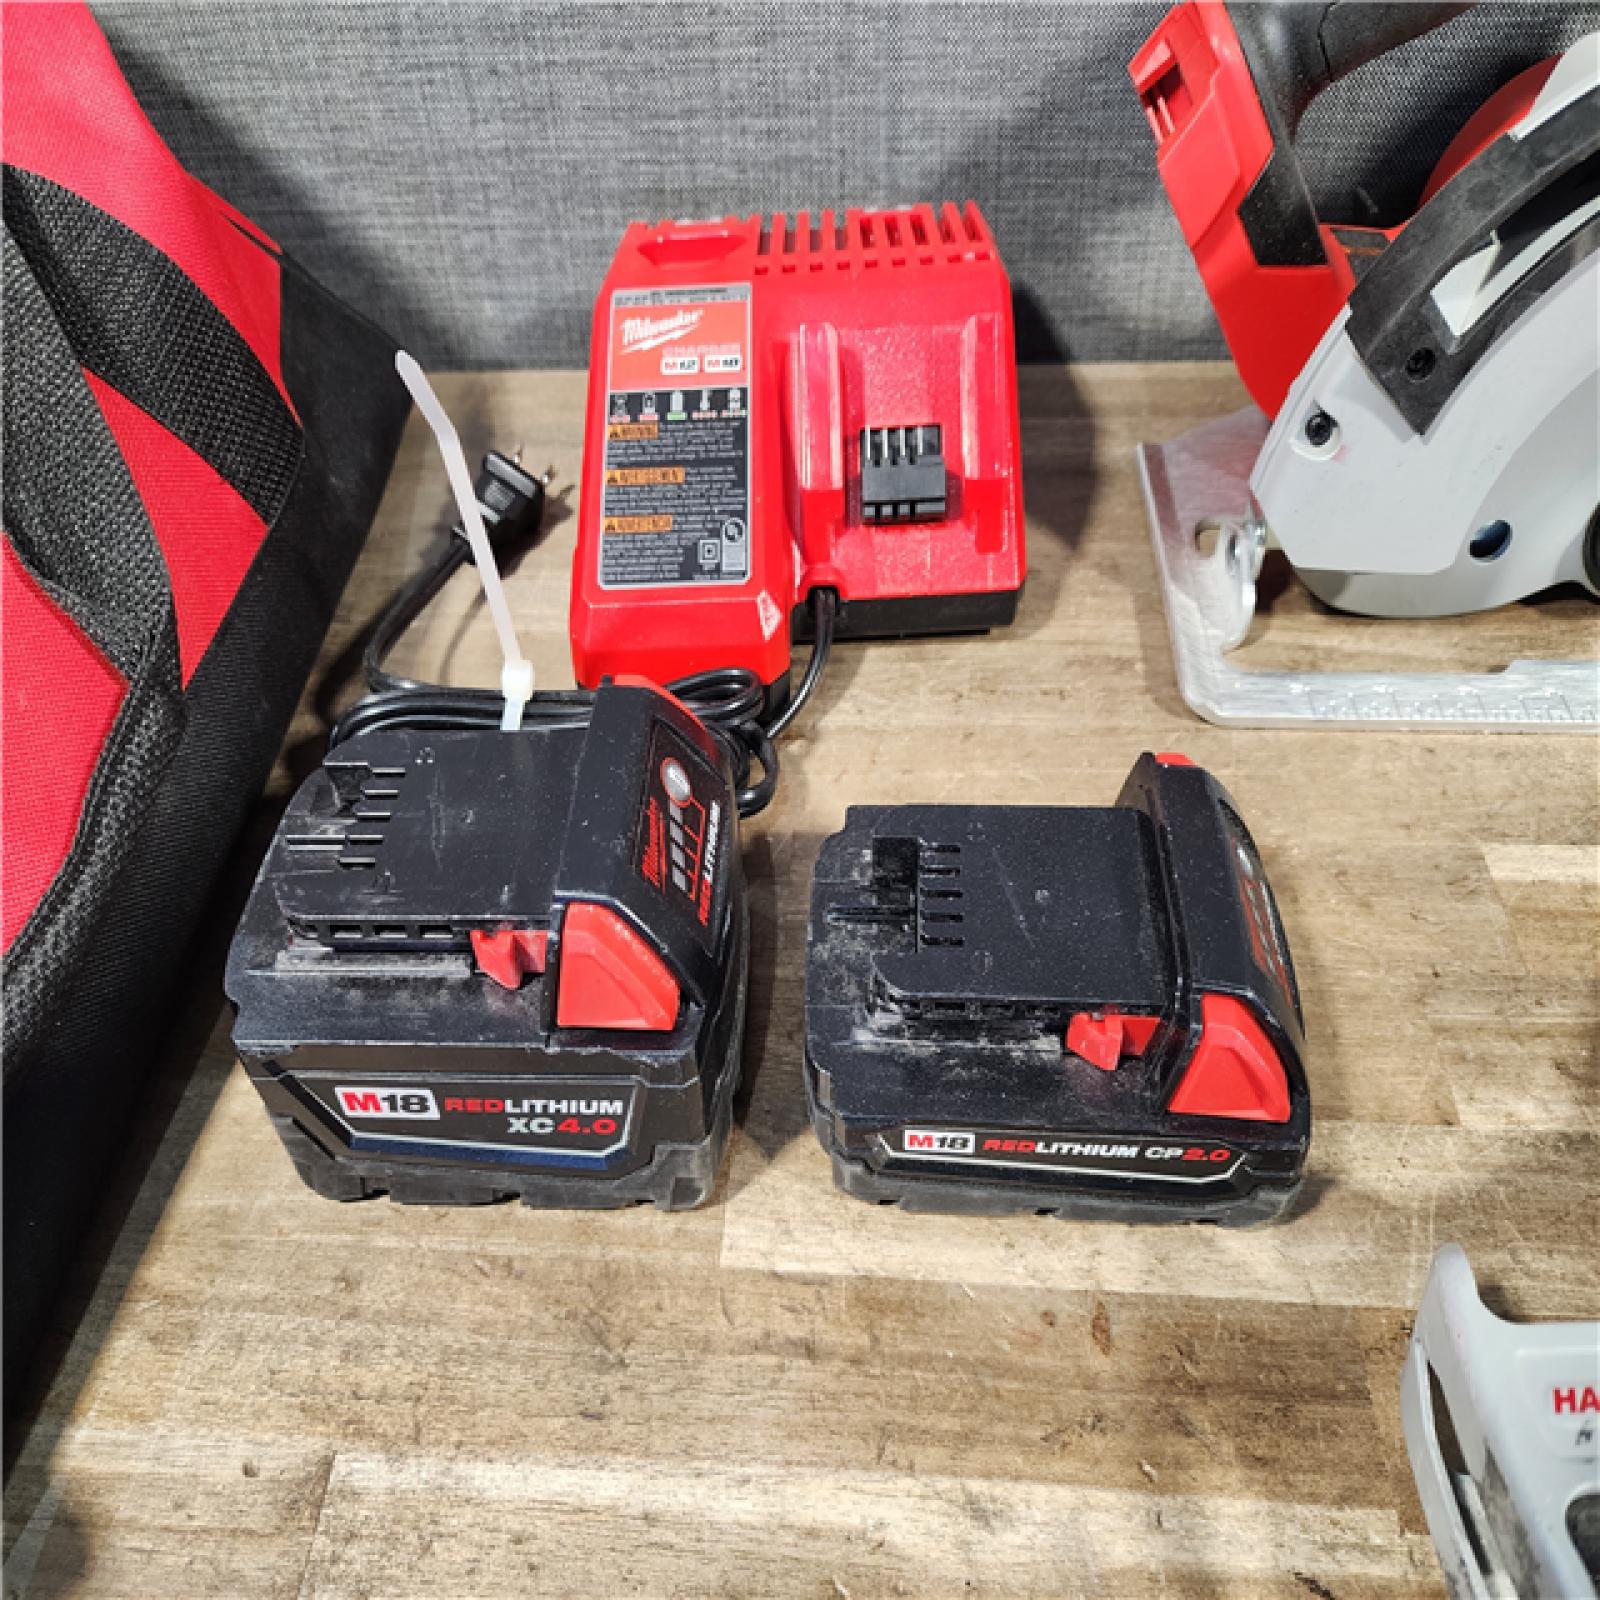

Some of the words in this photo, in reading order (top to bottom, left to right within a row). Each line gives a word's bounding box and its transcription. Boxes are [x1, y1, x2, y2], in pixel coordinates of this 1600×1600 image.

[342, 1091, 431, 1113] M18
[443, 1097, 623, 1115] REDLITHIUM
[907, 1134, 972, 1149] M18
[982, 1138, 1140, 1158] REDLITHIUM
[1144, 1147, 1231, 1161] CP2.0
